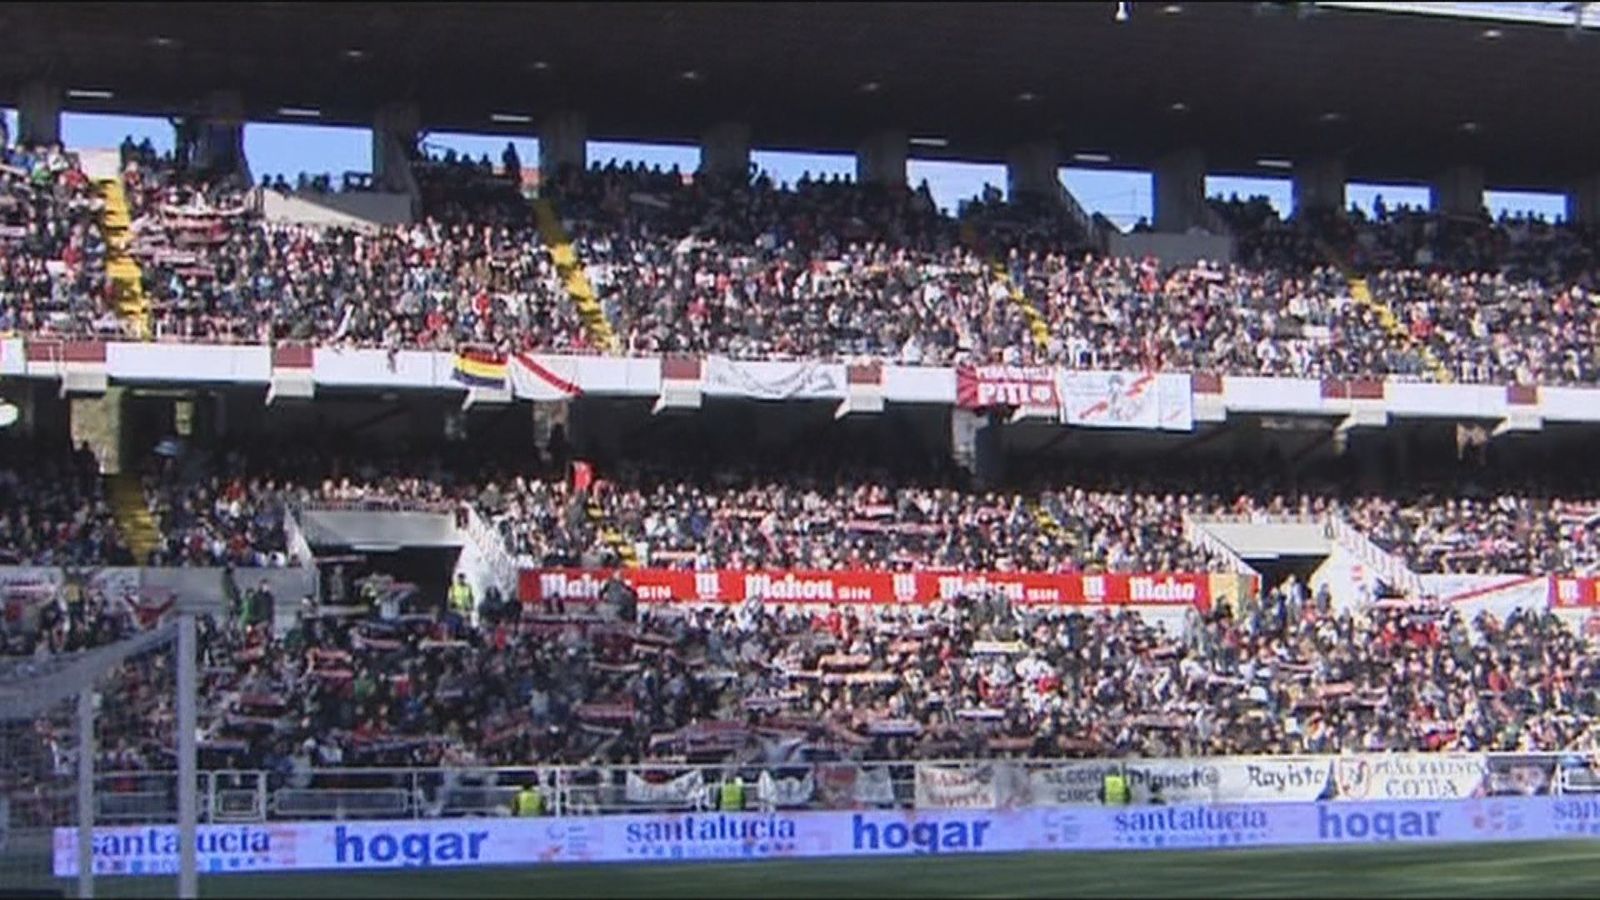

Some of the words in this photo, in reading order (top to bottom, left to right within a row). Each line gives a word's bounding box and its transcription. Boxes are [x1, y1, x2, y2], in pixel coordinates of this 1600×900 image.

[539, 573, 632, 599] Mah
[744, 573, 834, 600] Mahou
[837, 586, 871, 600] SIN
[852, 813, 992, 853] hogar
[1318, 805, 1442, 842] hogar
[335, 825, 489, 867] hogar
